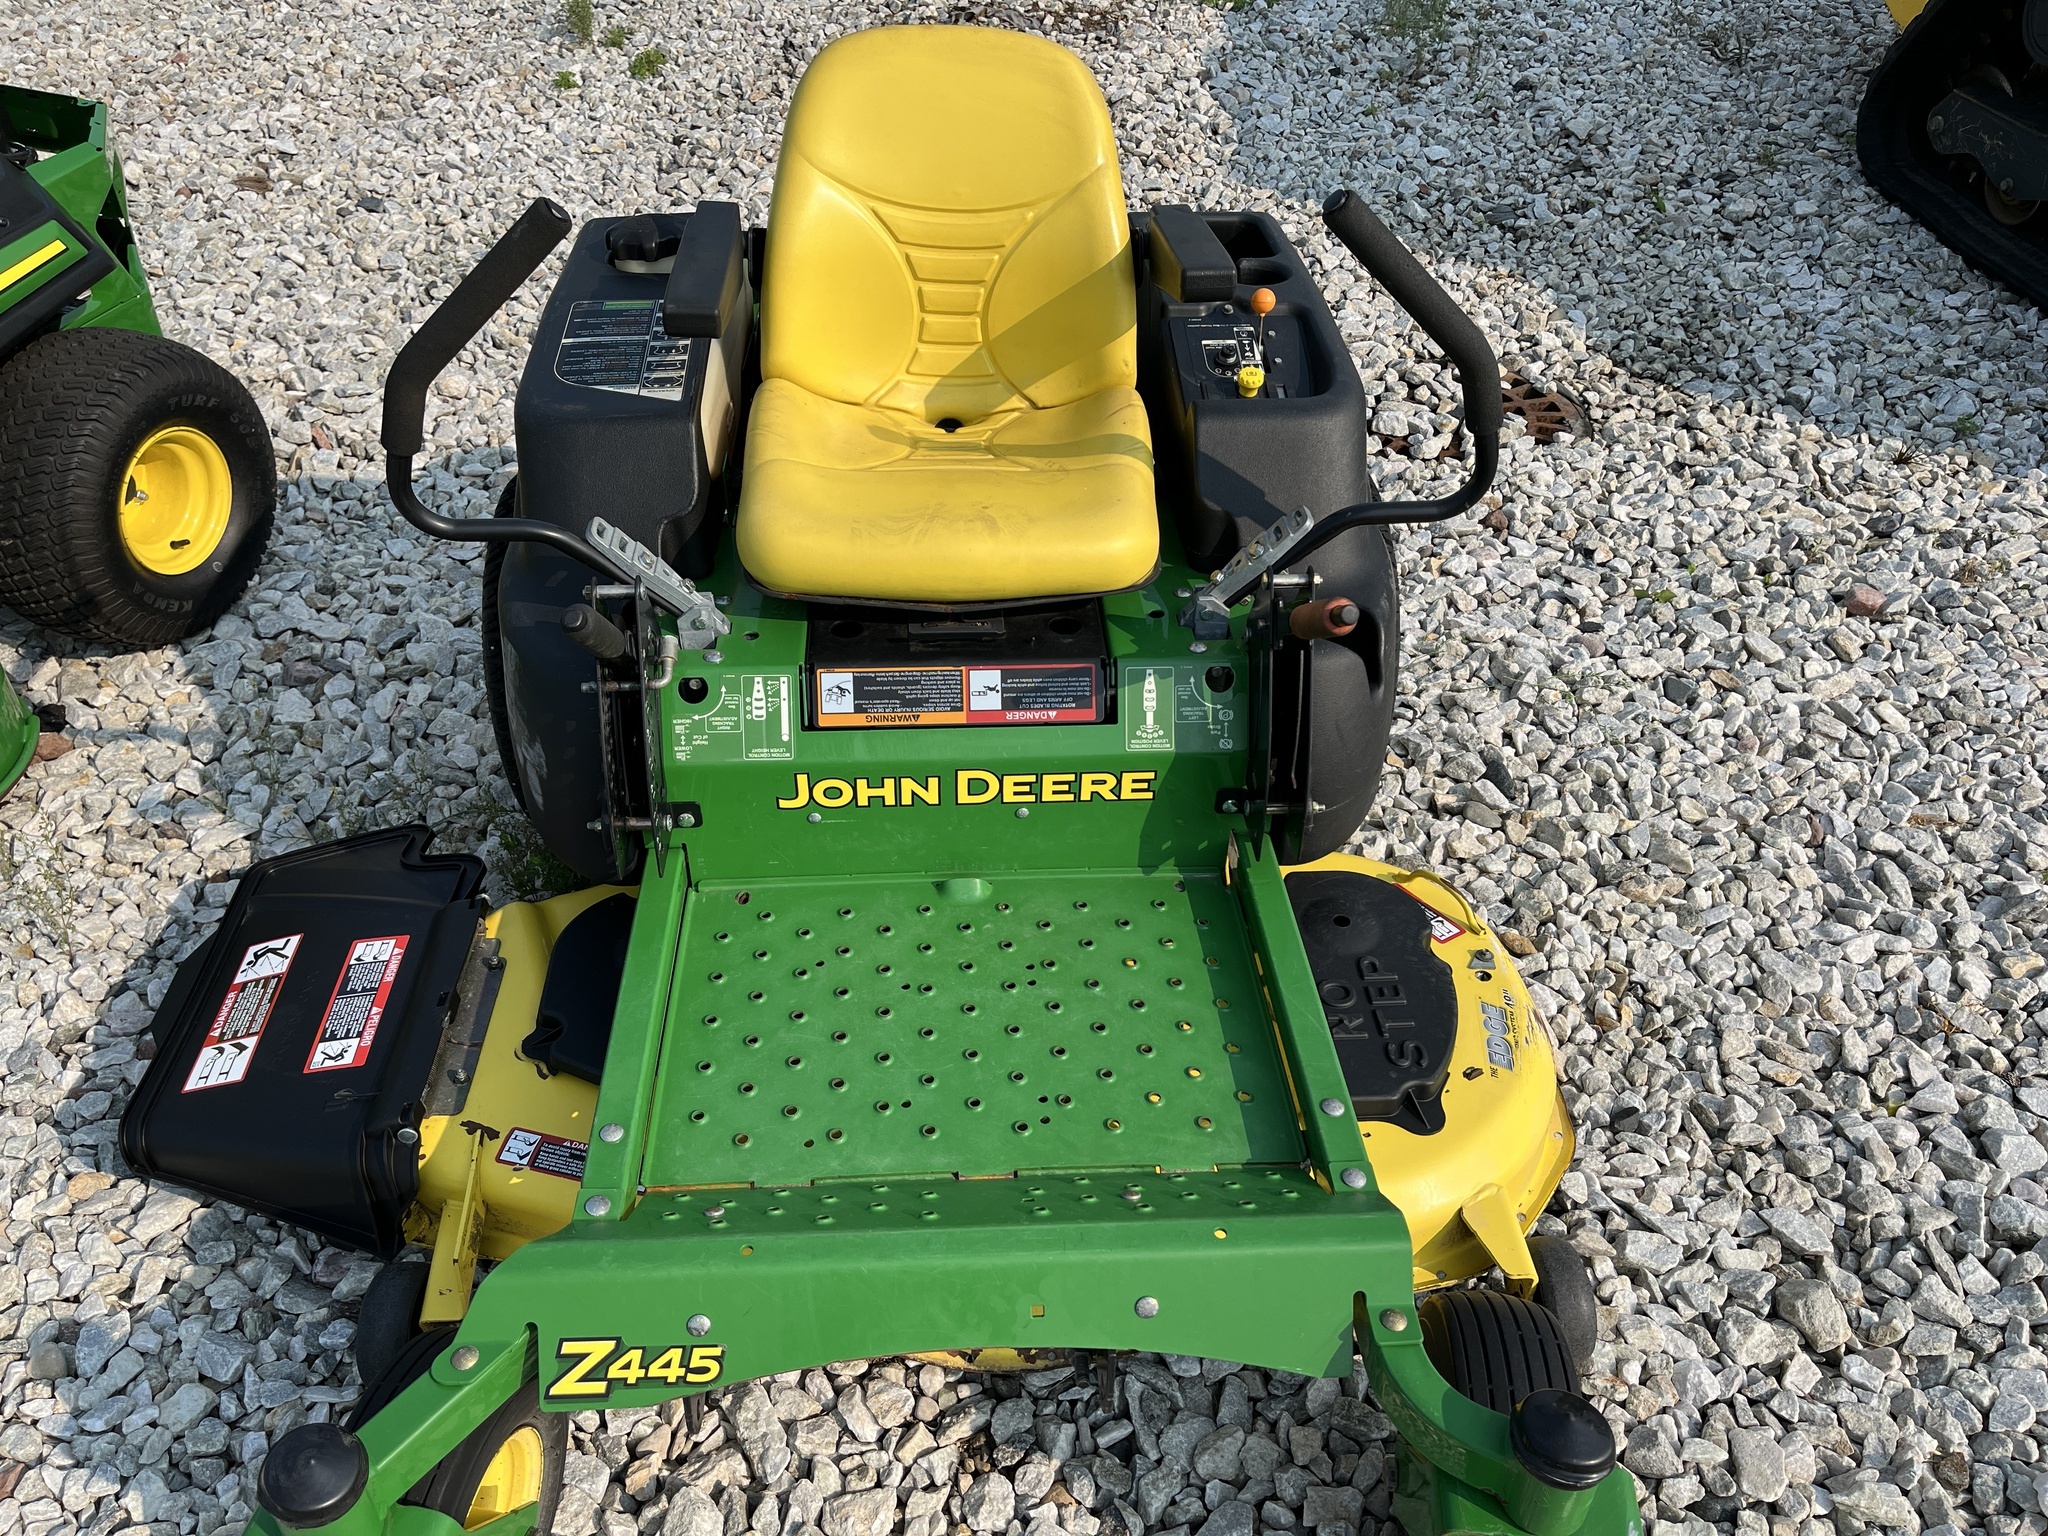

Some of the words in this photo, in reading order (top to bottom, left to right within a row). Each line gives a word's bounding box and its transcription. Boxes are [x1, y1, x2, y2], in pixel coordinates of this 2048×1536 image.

[168, 393, 219, 411] TURF
[133, 581, 193, 613] KENDA
[865, 715, 912, 723] WARNING
[1006, 711, 1047, 720] DANGER
[776, 772, 941, 810] JOHN
[954, 769, 1157, 805] DEERE
[383, 955, 403, 982] DANGER
[216, 991, 238, 1027] DANGER
[1319, 979, 1368, 1040] NO
[1358, 956, 1429, 1068] STEP
[360, 1014, 381, 1047] PELIGRO
[1480, 1001, 1514, 1071] EDGE
[1490, 1066, 1499, 1078] THE
[544, 1336, 725, 1399] Z445
